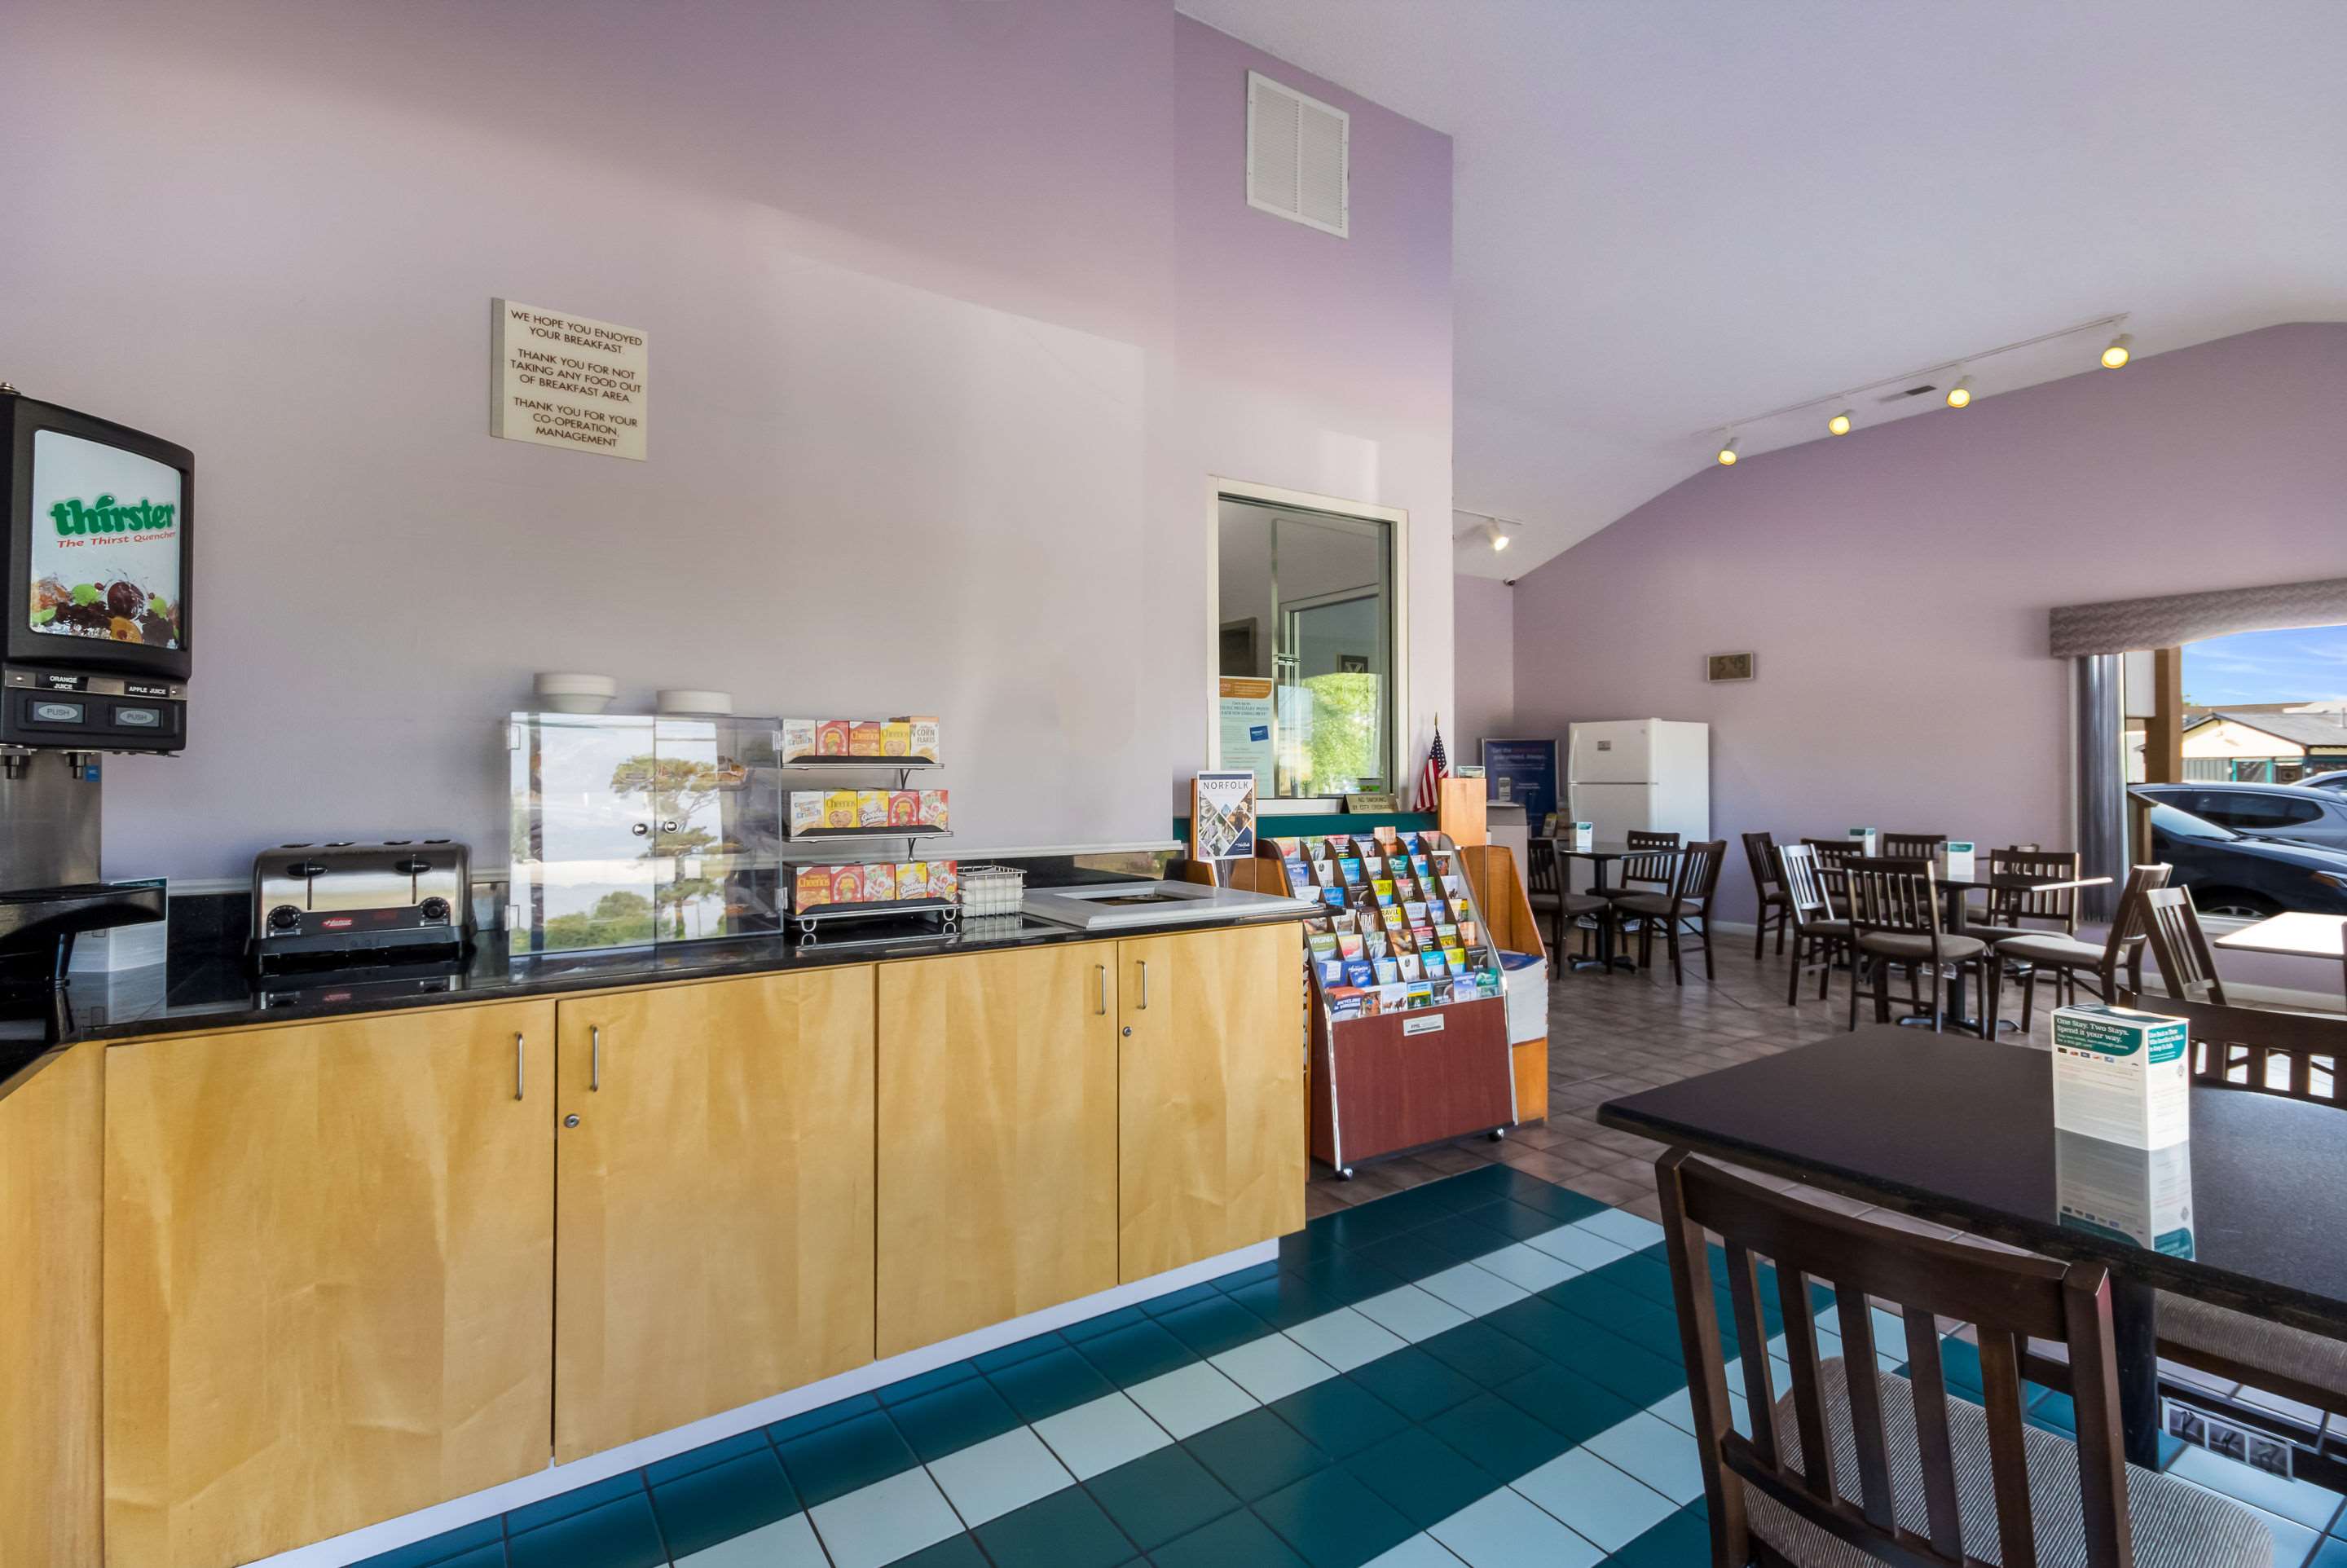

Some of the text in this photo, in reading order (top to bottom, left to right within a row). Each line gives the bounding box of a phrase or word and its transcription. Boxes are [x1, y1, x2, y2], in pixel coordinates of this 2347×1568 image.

[511, 310, 642, 346] WE HOPE YOU ENJOYED
[529, 327, 561, 341] YOUR
[518, 348, 636, 380] THANK YOU FOR NOT
[510, 359, 641, 394] TAKING ANY FOOD OUT
[520, 374, 535, 385] OF
[539, 378, 598, 397] BREAKFAST
[515, 397, 637, 427] THANK YOU FOR YOUR
[535, 427, 618, 447] MANAGEMENT
[51, 495, 175, 536] thirster
[57, 531, 176, 548] The Thirst Quencher
[50, 676, 77, 684] ORANGE
[129, 685, 148, 694] APPLE
[46, 708, 70, 716] PUSH
[126, 712, 148, 720] PUSH
[917, 729, 935, 737] CORN
[1203, 782, 1248, 790] NORFOLK
[827, 799, 856, 809] Cheerios
[799, 879, 830, 888] Cheerios
[1309, 935, 1335, 944] VIRGINIA
[2057, 1018, 2129, 1036] One Stay. Two Stays.
[2057, 1025, 2078, 1034] Spend
[2086, 1031, 2104, 1039] your
[2105, 1034, 2122, 1043] way.
